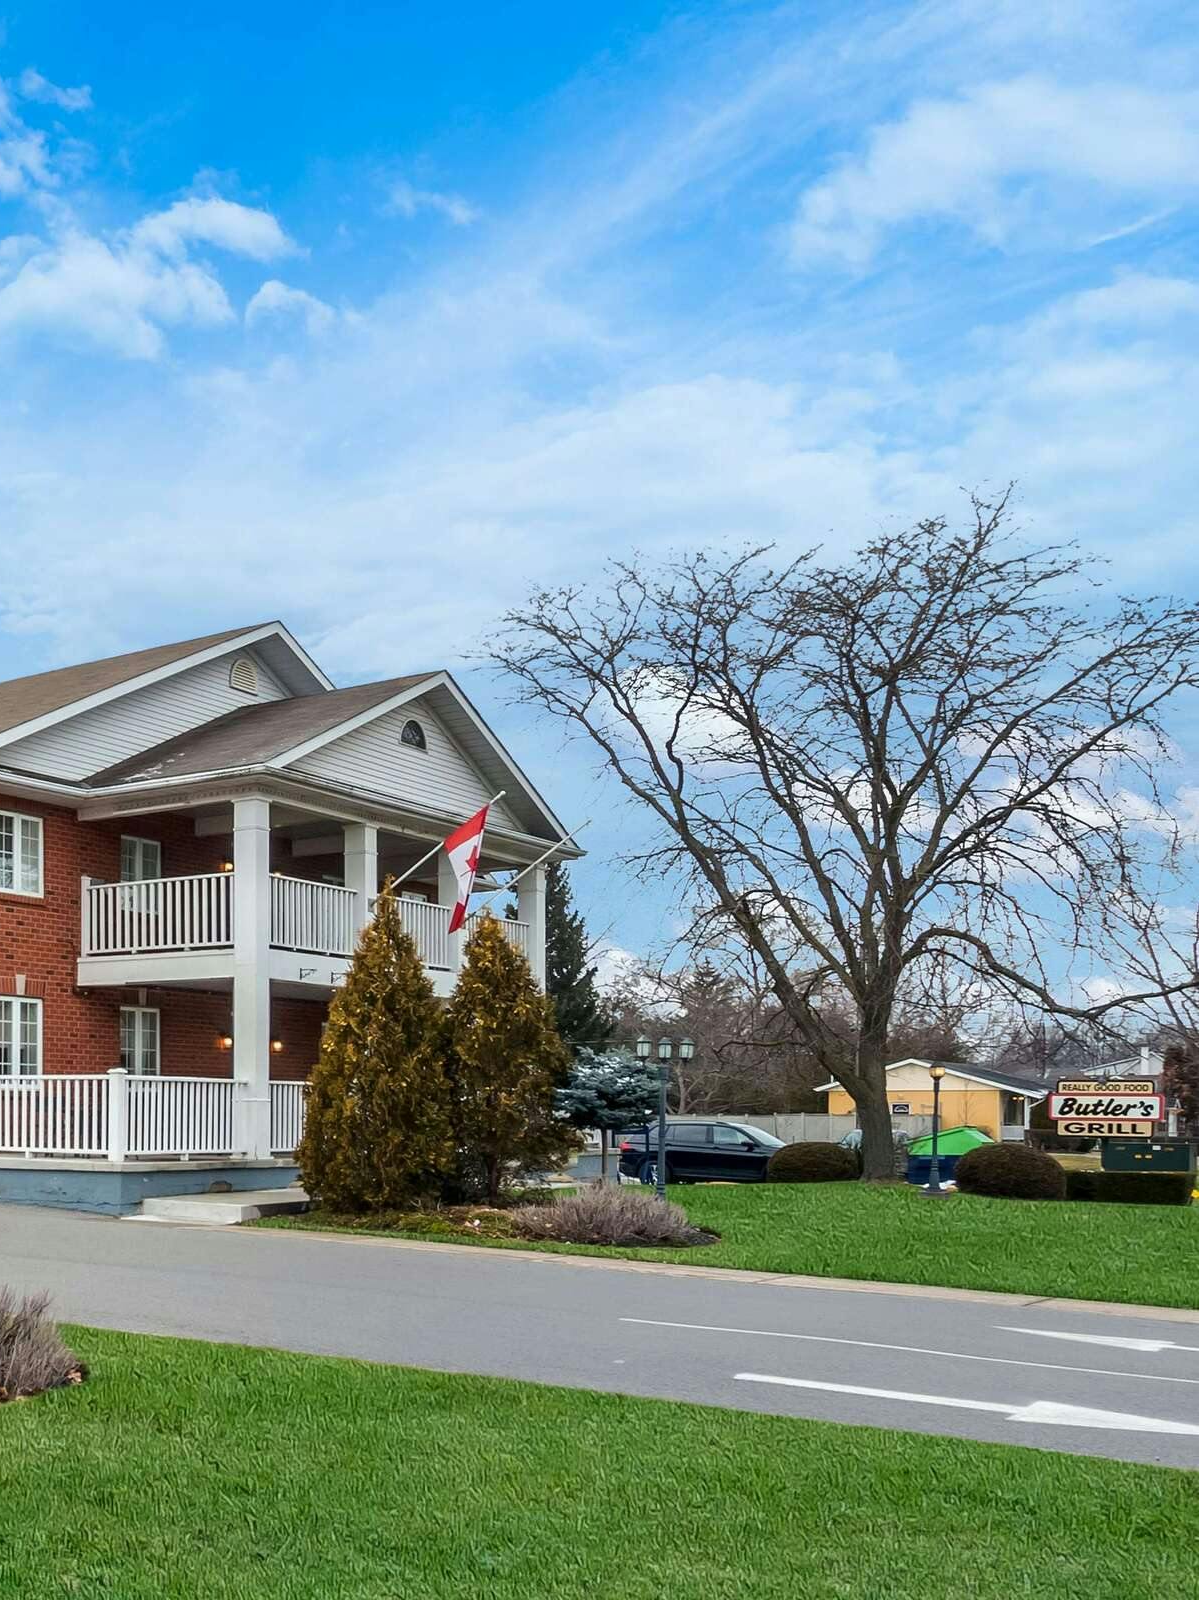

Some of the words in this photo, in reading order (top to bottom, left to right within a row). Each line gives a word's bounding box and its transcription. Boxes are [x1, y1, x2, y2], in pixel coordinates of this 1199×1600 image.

[1061, 1083, 1091, 1092] REALLY
[1093, 1083, 1121, 1092] GOOD
[1123, 1083, 1149, 1092] FOOD
[1058, 1097, 1154, 1117] Butler's
[1063, 1122, 1145, 1135] GRILL
